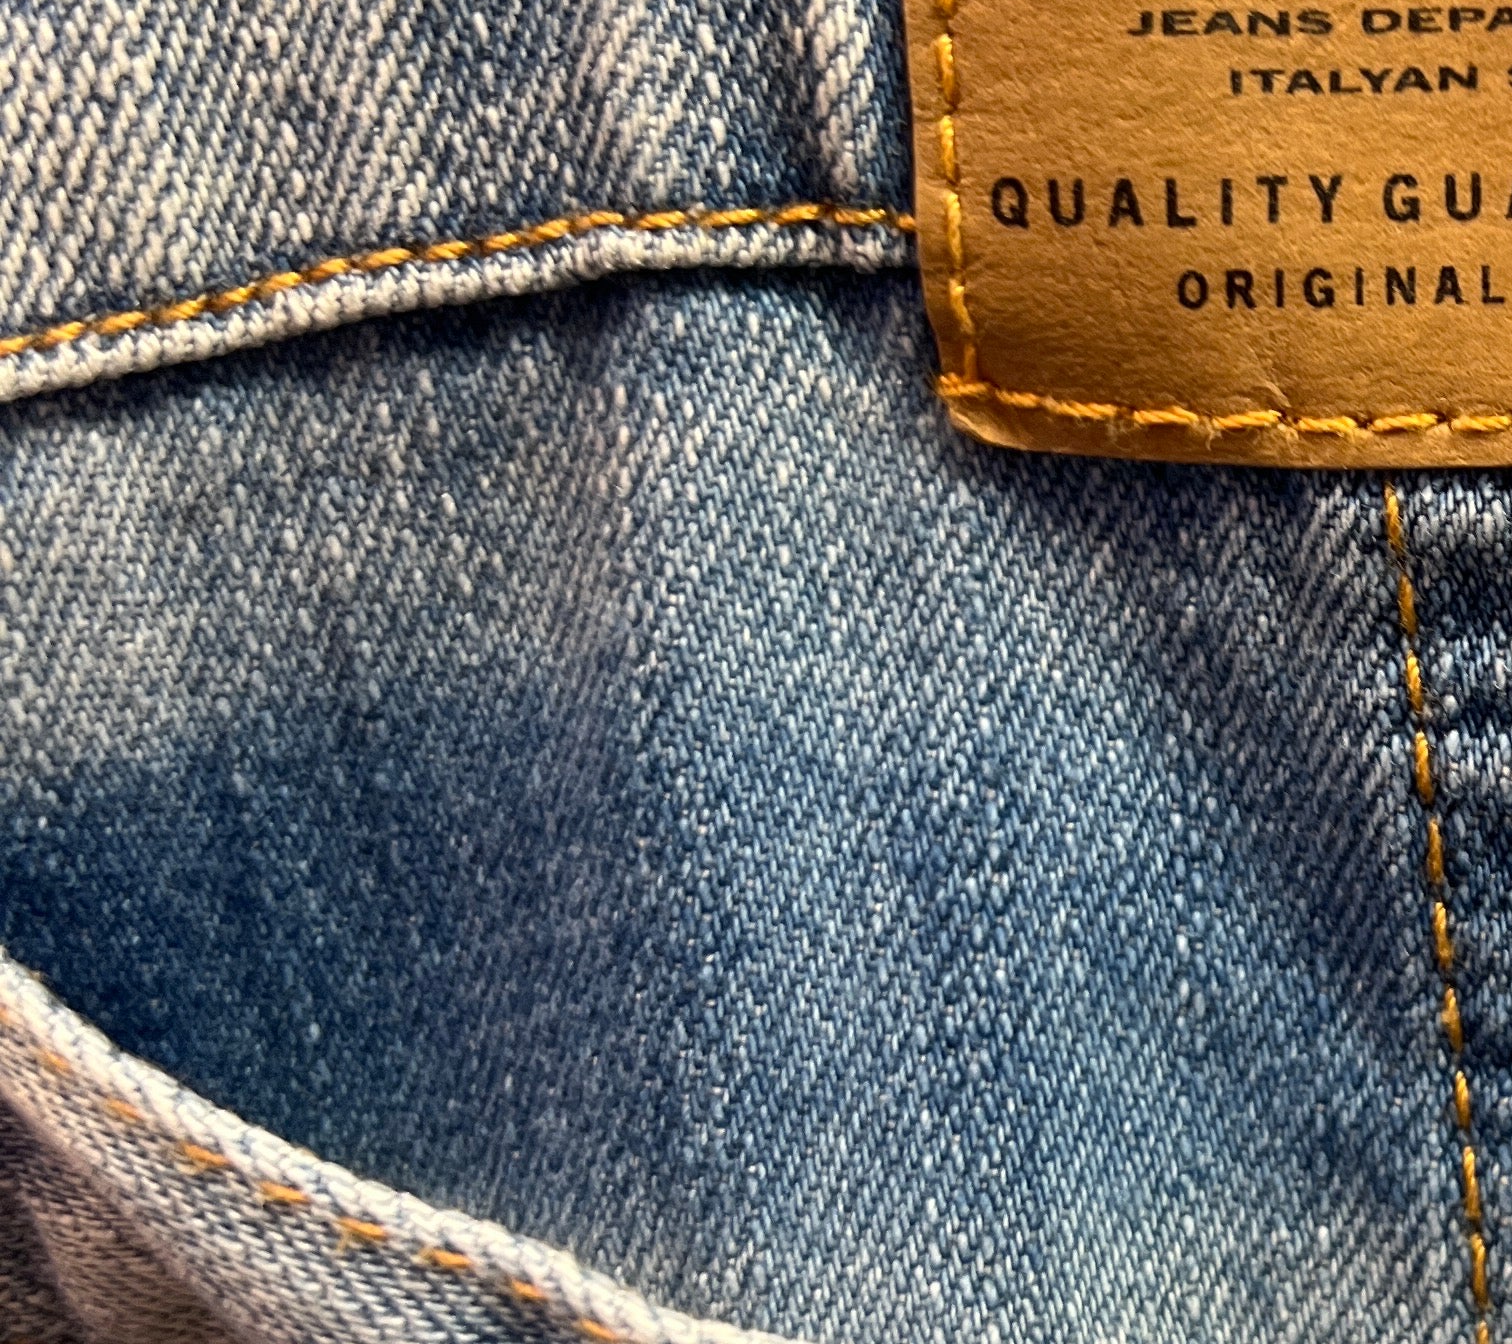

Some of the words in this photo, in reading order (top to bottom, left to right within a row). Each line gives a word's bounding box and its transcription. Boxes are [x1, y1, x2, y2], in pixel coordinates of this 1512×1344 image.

[1126, 8, 1334, 37] JEANS
[1230, 62, 1480, 96] ITALYAN
[986, 173, 1343, 234] QUALITY
[1171, 264, 1506, 312] ORIGINAL
